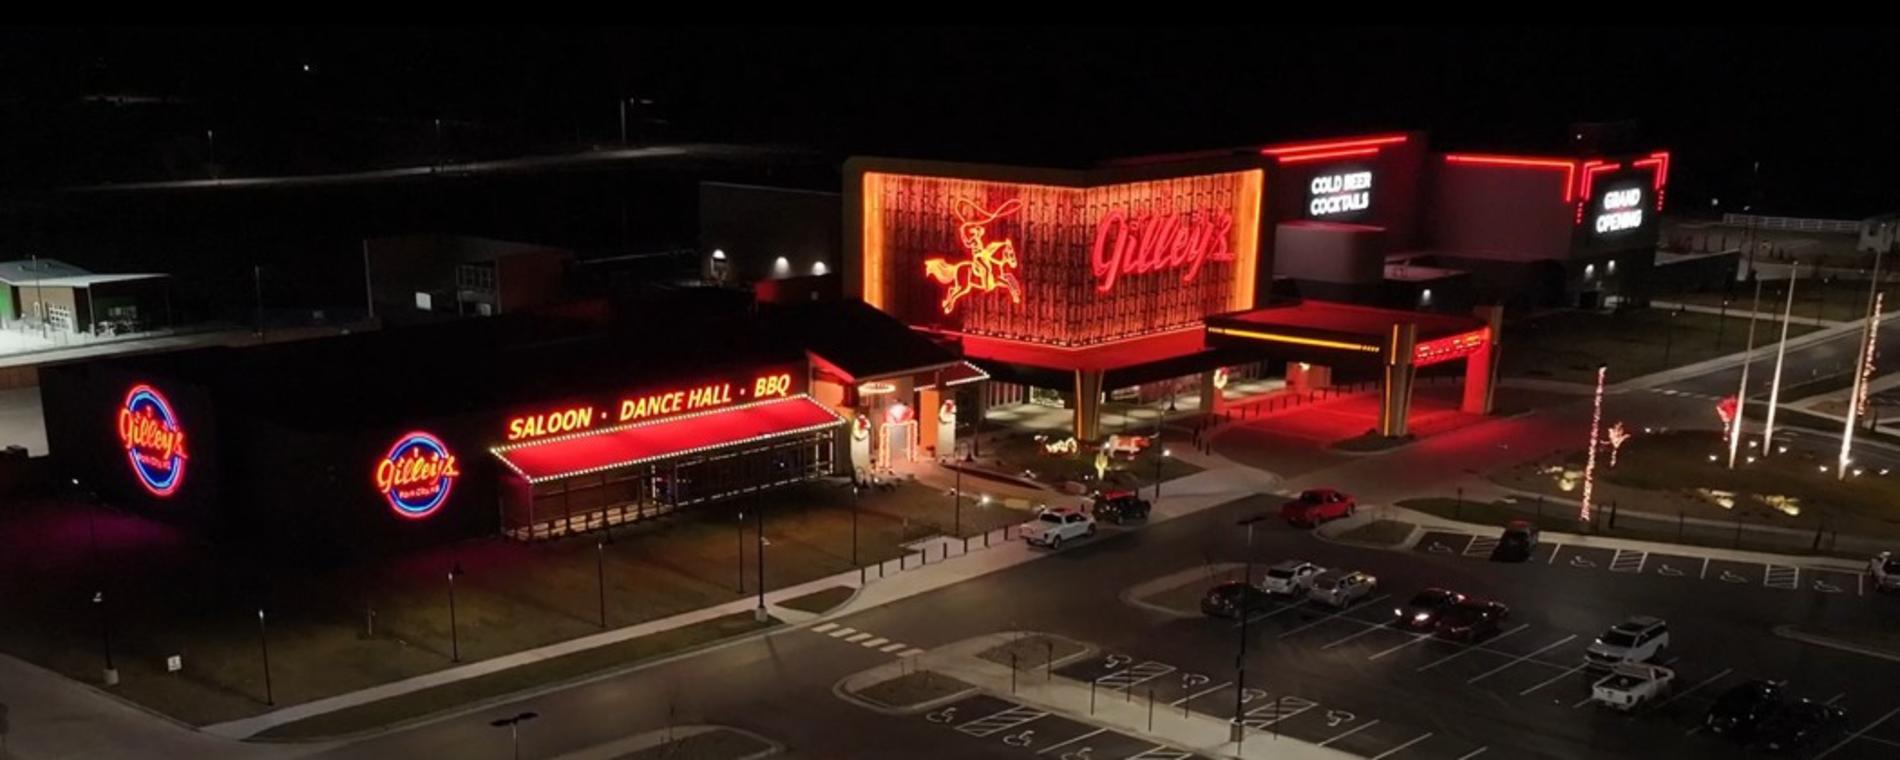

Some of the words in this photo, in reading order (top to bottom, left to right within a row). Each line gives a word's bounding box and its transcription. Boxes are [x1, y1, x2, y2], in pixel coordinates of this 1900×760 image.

[1092, 209, 1235, 292] Gilley's
[508, 407, 593, 440] SALOON
[619, 391, 685, 422] DANCE
[686, 384, 732, 409] HALL
[754, 374, 790, 397] BBQ
